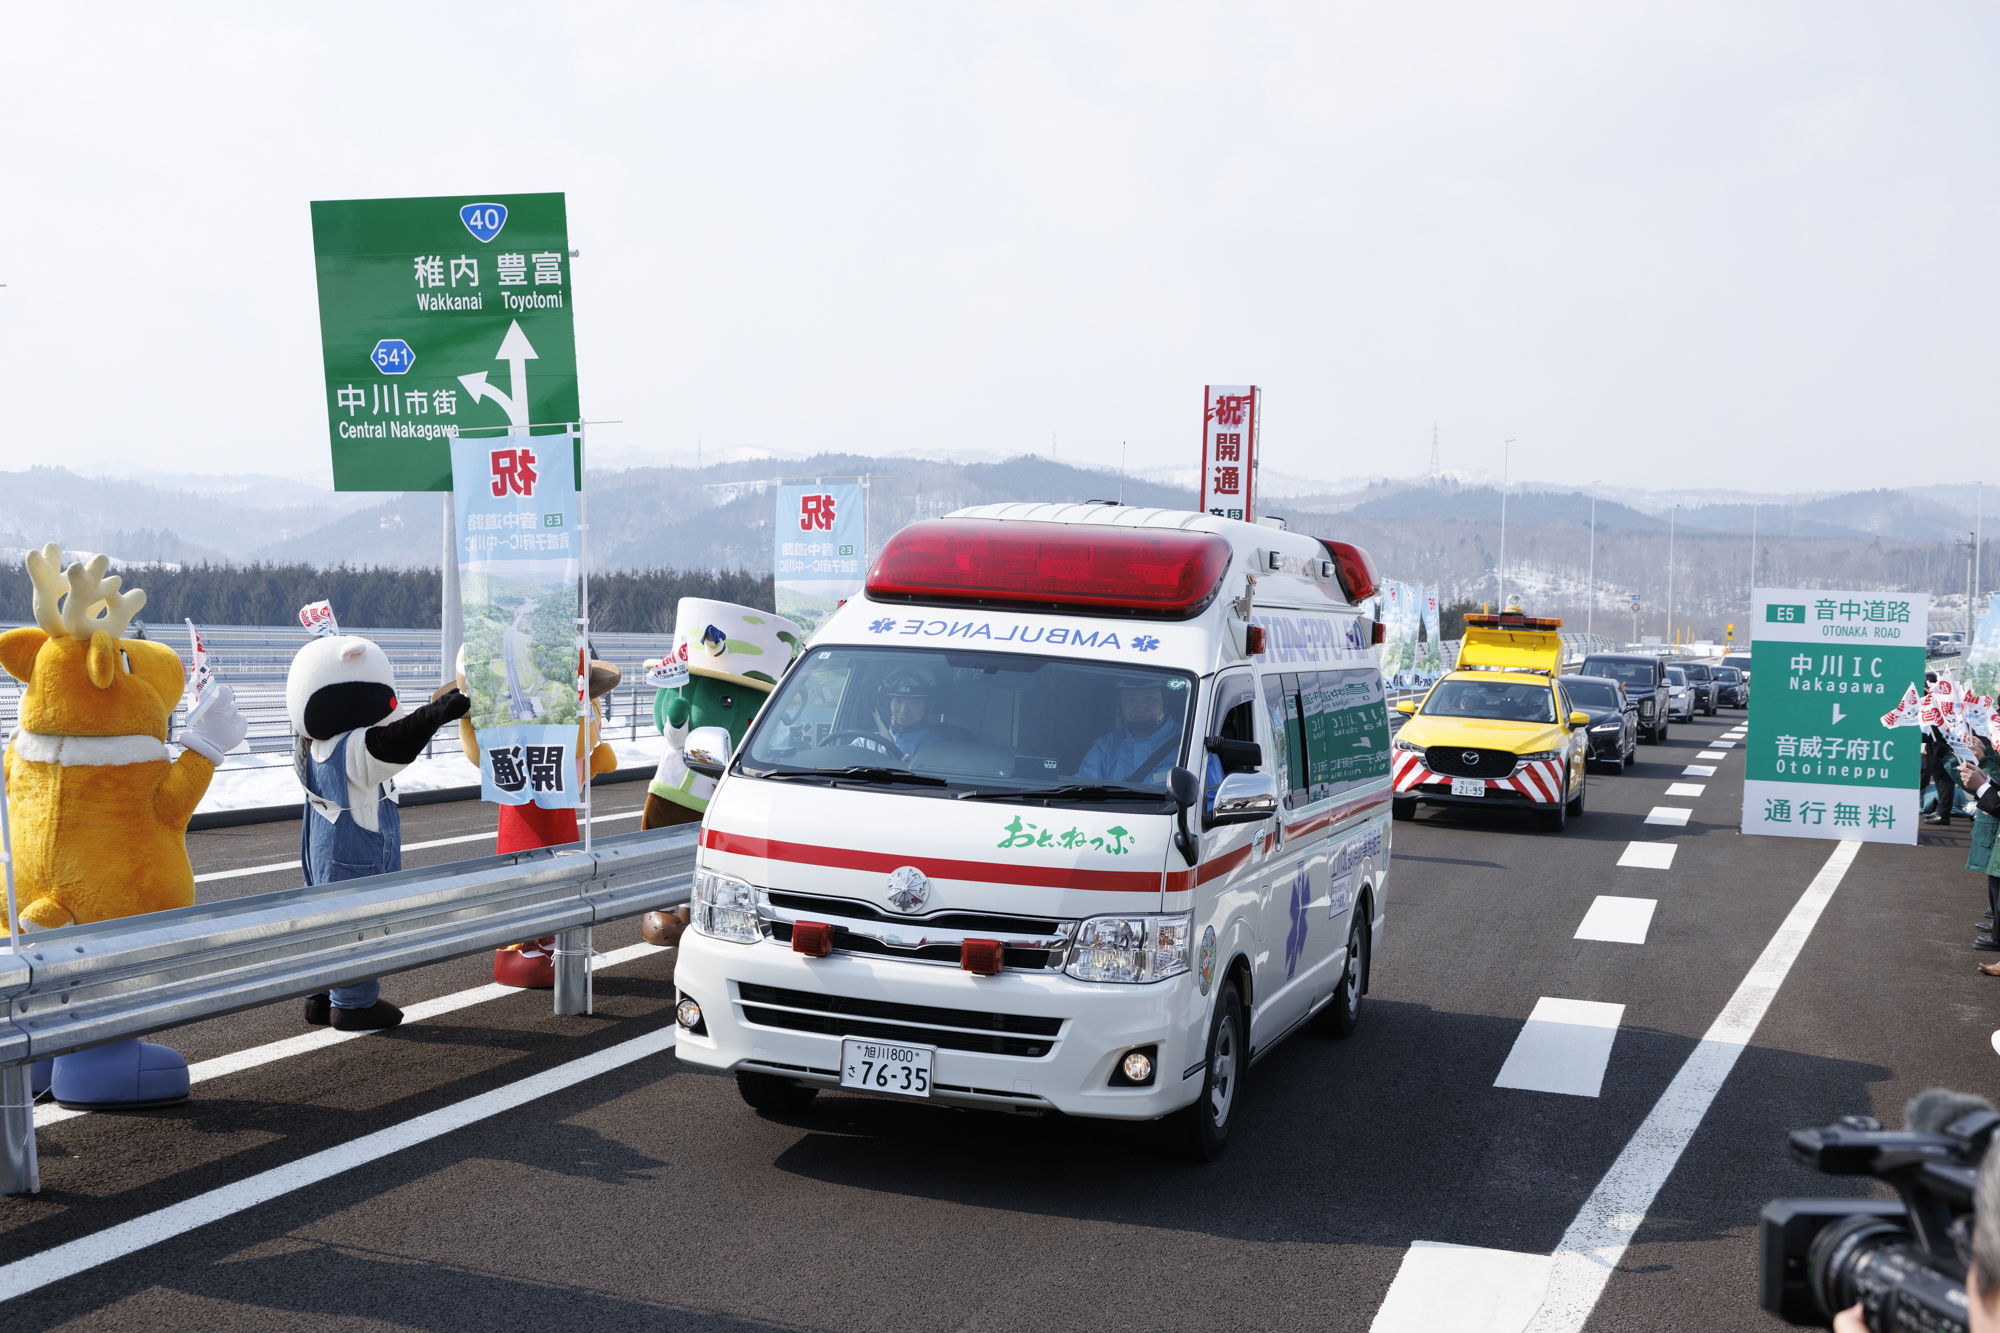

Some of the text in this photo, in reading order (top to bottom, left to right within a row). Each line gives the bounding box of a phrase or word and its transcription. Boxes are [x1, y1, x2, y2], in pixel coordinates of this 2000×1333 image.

[470, 208, 499, 230] 40
[413, 251, 562, 288] 稚内 豊富
[416, 290, 563, 312] Wakkanai Toyotomi
[377, 348, 408, 366] 541
[337, 383, 457, 417] 中川市街
[339, 420, 459, 441] Central Nakagawa
[1213, 395, 1242, 495] 祝開通
[1777, 598, 1911, 624] E5 音中道路
[1822, 625, 1901, 639] OTONAKA ROAD
[1789, 676, 1885, 694] Nakagawa
[1775, 734, 1894, 761] 音威子府IC
[1776, 759, 1889, 780] Otoineppu
[1459, 786, 1483, 795] 21-95
[1764, 798, 1896, 830] 通行無料
[848, 1060, 928, 1092] さ 76-35
